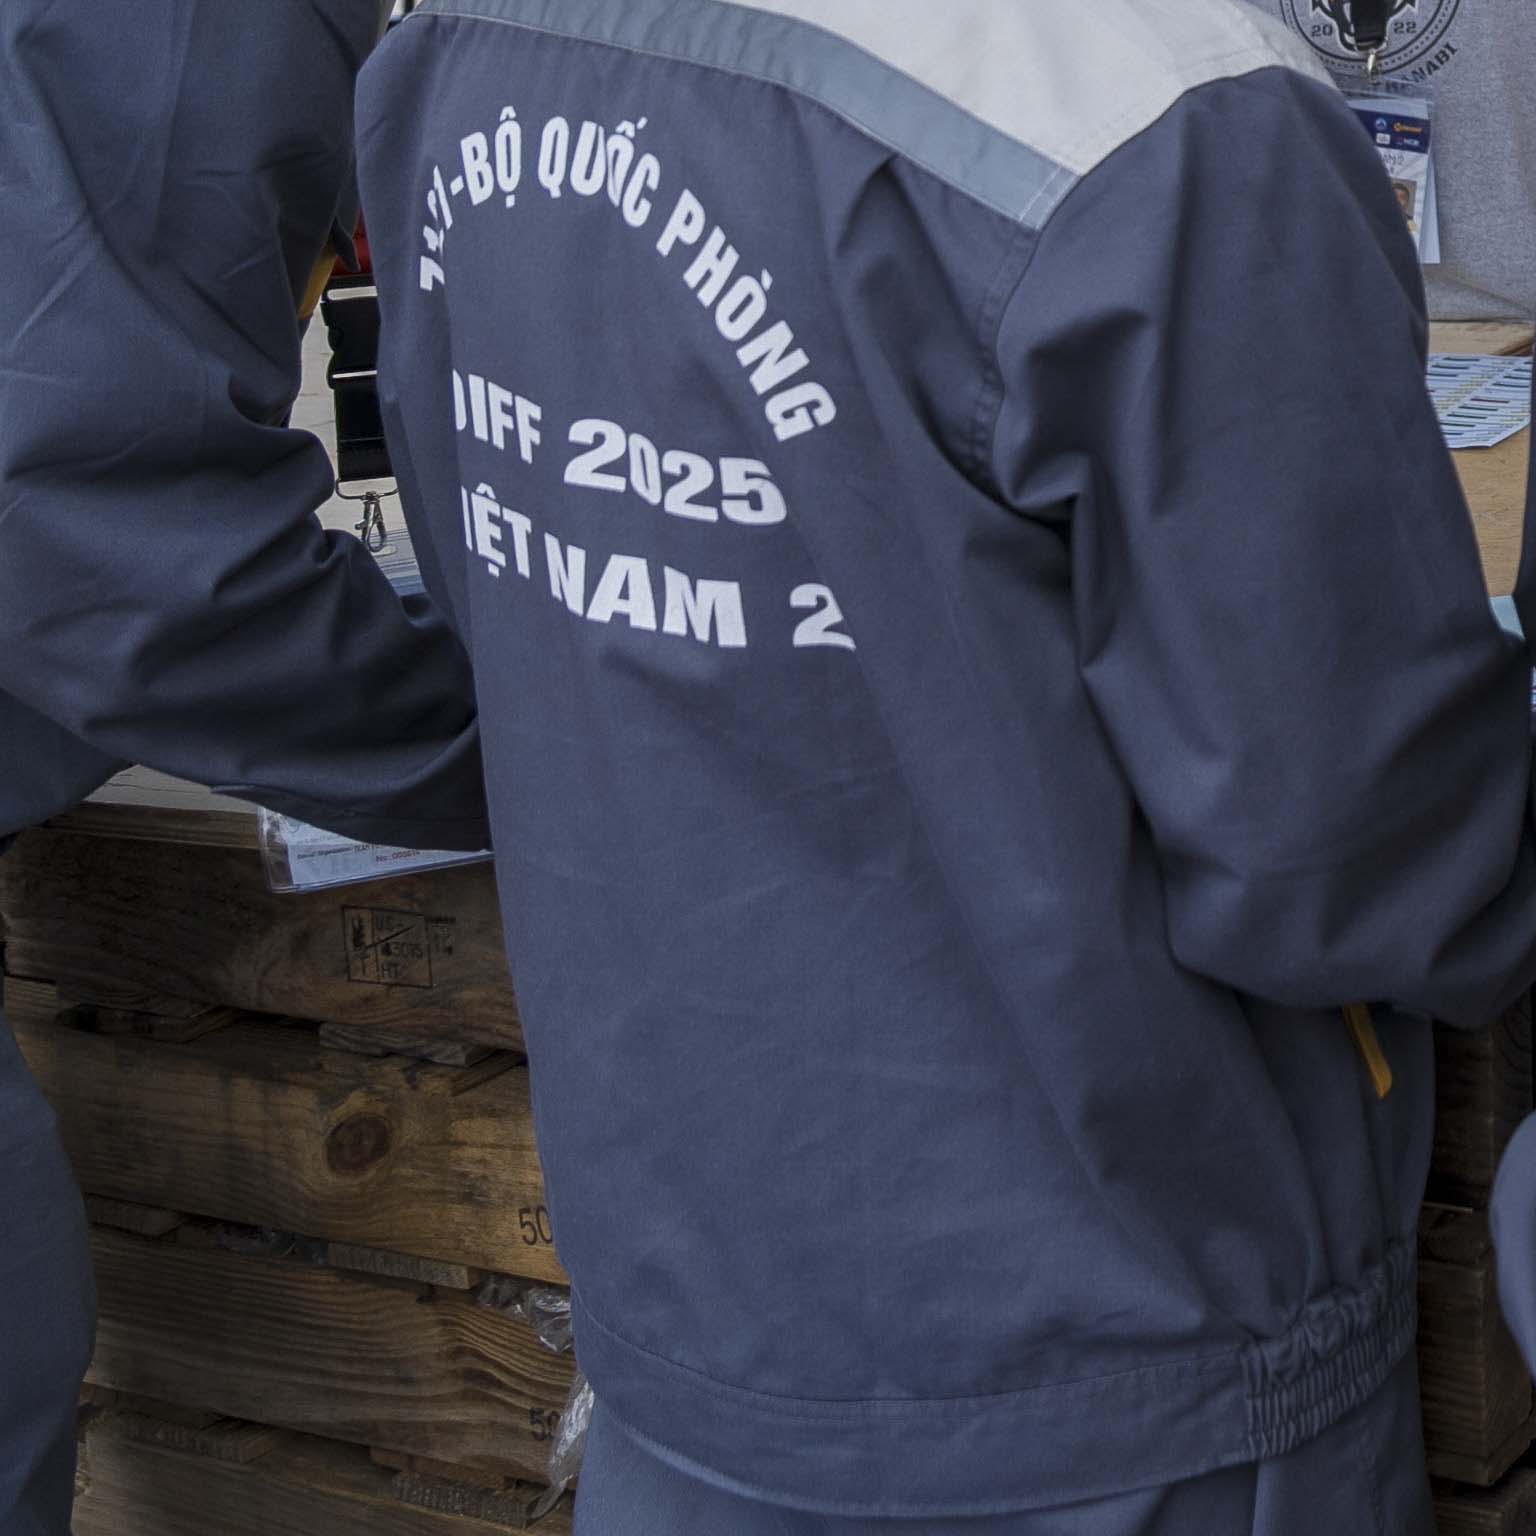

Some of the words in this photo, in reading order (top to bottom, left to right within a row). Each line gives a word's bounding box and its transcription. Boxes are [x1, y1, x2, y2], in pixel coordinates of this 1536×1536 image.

[1311, 23, 1334, 38] 20
[1393, 20, 1417, 35] 22
[537, 117, 661, 228] QUỐC
[656, 188, 837, 442] PHÒNG
[563, 418, 787, 525] 2025
[461, 482, 532, 579] IỆT
[544, 532, 747, 648] NAM
[790, 583, 857, 651] 2
